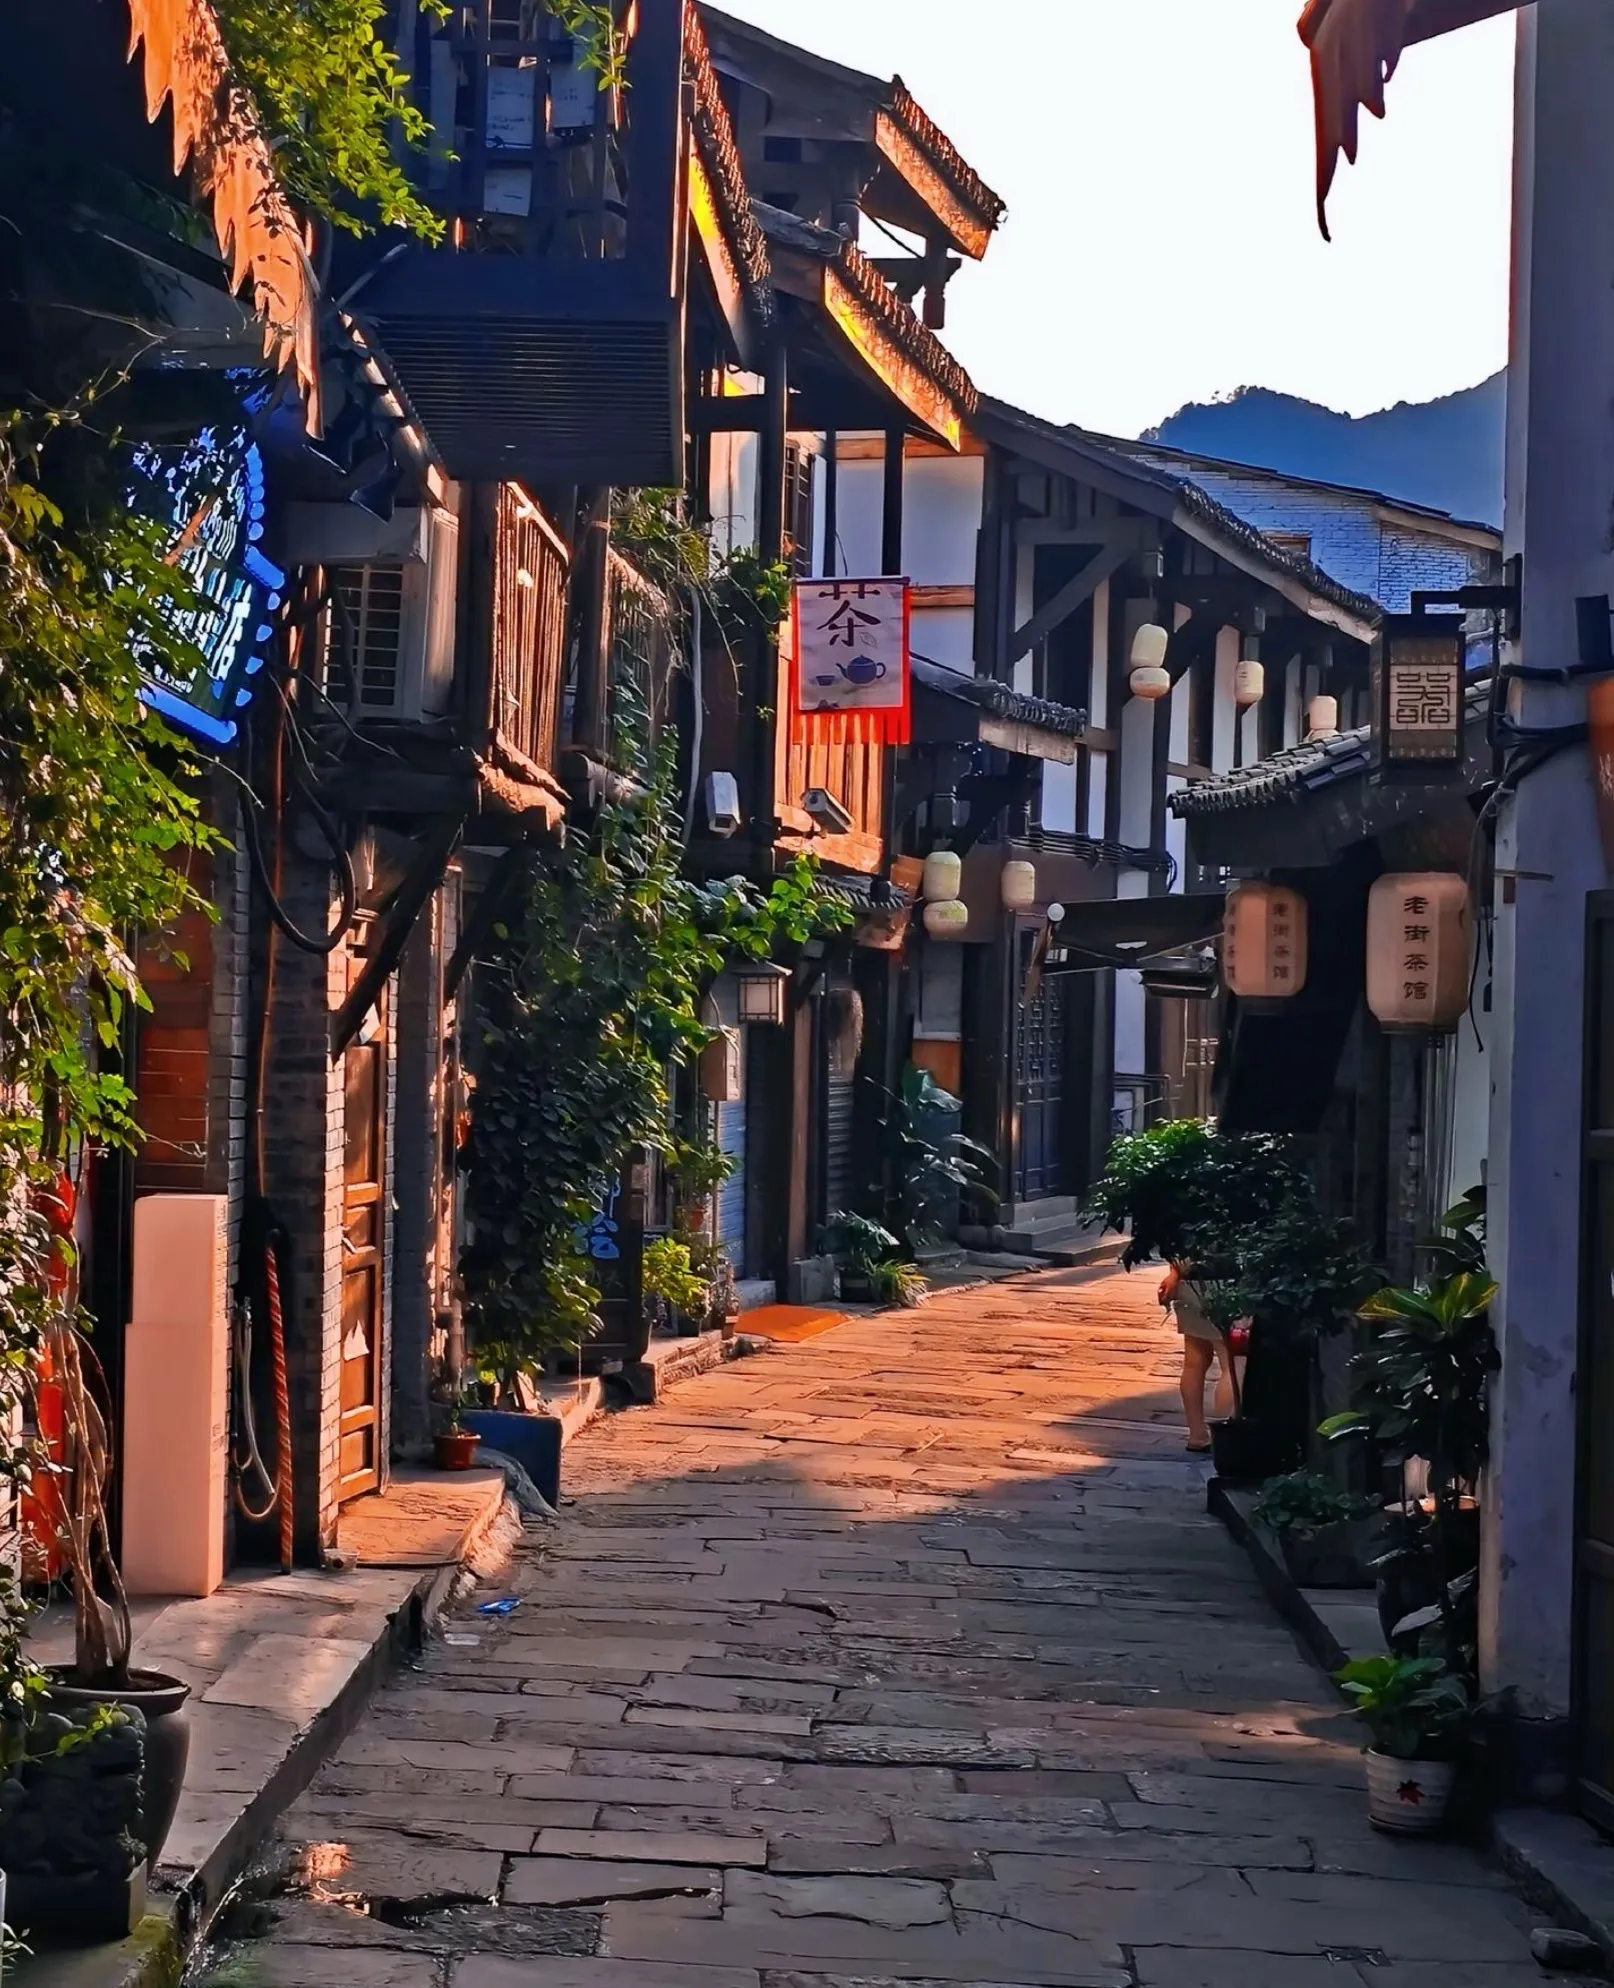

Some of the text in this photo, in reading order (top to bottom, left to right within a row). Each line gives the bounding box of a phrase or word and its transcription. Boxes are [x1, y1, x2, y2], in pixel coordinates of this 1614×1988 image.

[817, 583, 881, 647] 茶
[1403, 896, 1430, 1000] 老街茶馆
